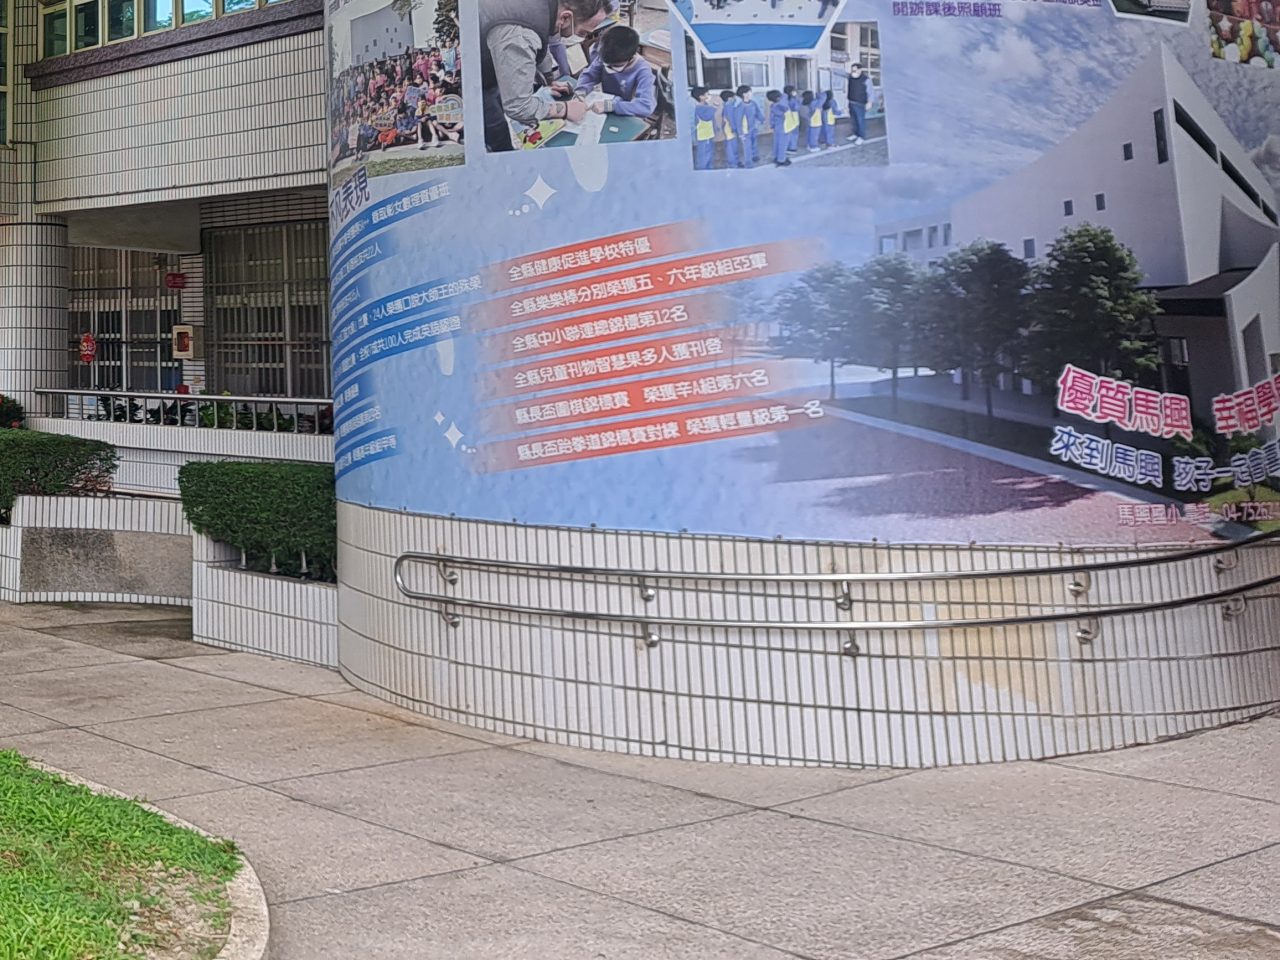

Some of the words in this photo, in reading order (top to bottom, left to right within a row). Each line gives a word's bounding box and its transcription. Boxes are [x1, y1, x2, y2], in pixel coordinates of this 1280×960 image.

[508, 235, 652, 282] 全縣健康促進學校特優
[1058, 363, 1193, 441] 優質馬興
[1211, 373, 1280, 440] 幸福學
[1050, 426, 1163, 488] 來到馬興
